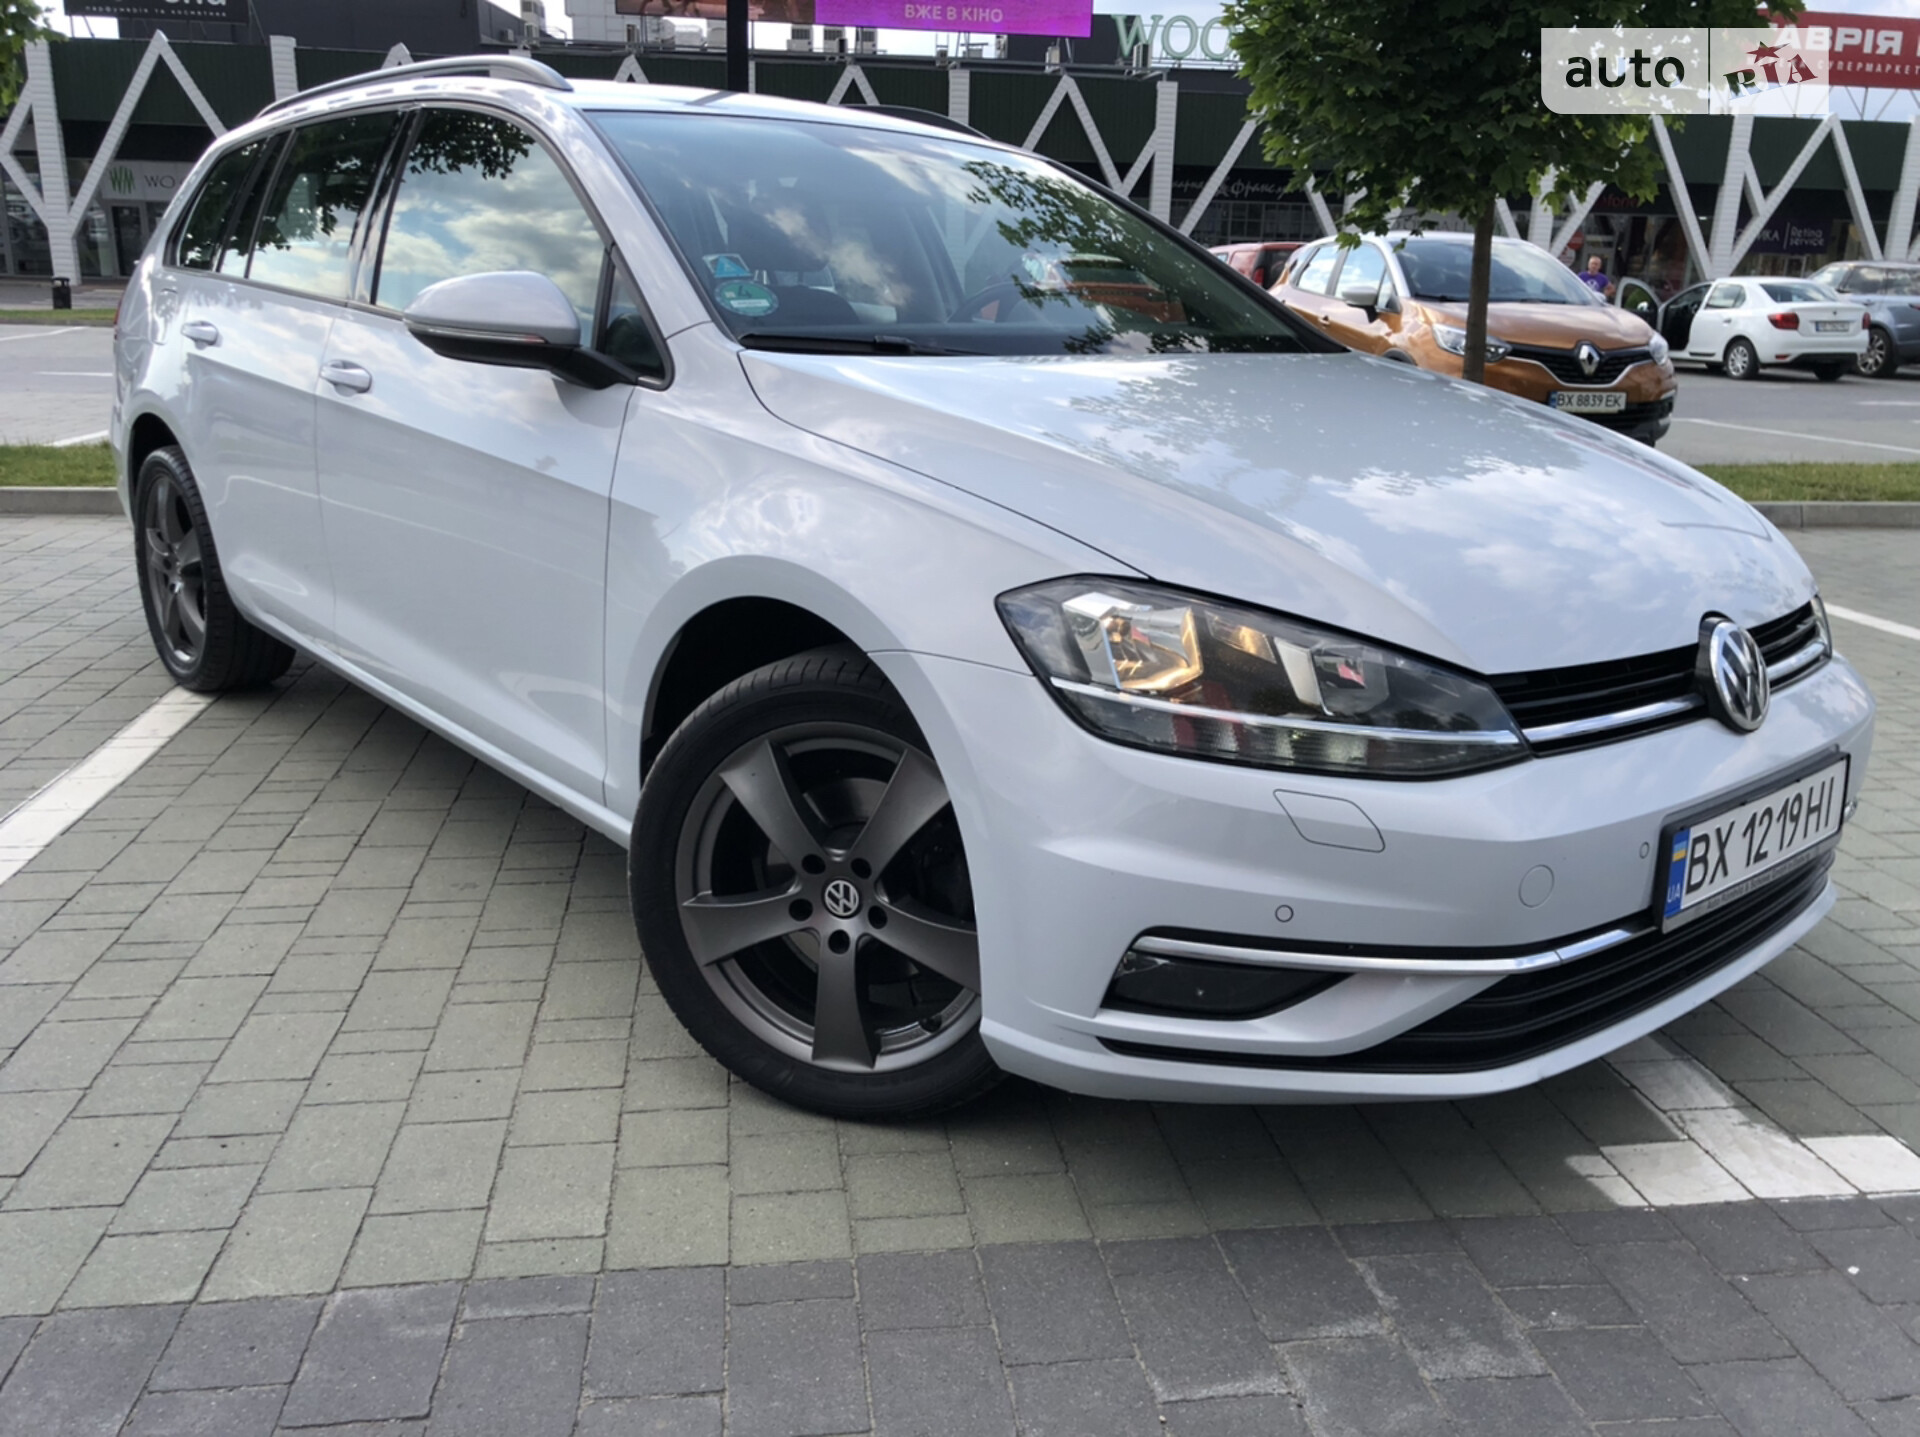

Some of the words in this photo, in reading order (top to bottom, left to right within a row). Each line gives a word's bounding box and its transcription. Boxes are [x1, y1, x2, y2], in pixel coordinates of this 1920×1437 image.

[904, 4, 942, 19] ВЖЕ
[946, 6, 957, 21] В
[961, 7, 1004, 23] КІНО
[1769, 22, 1904, 56] АВРІЯ
[1685, 820, 1736, 895] BX
[1666, 882, 1682, 903] UA
